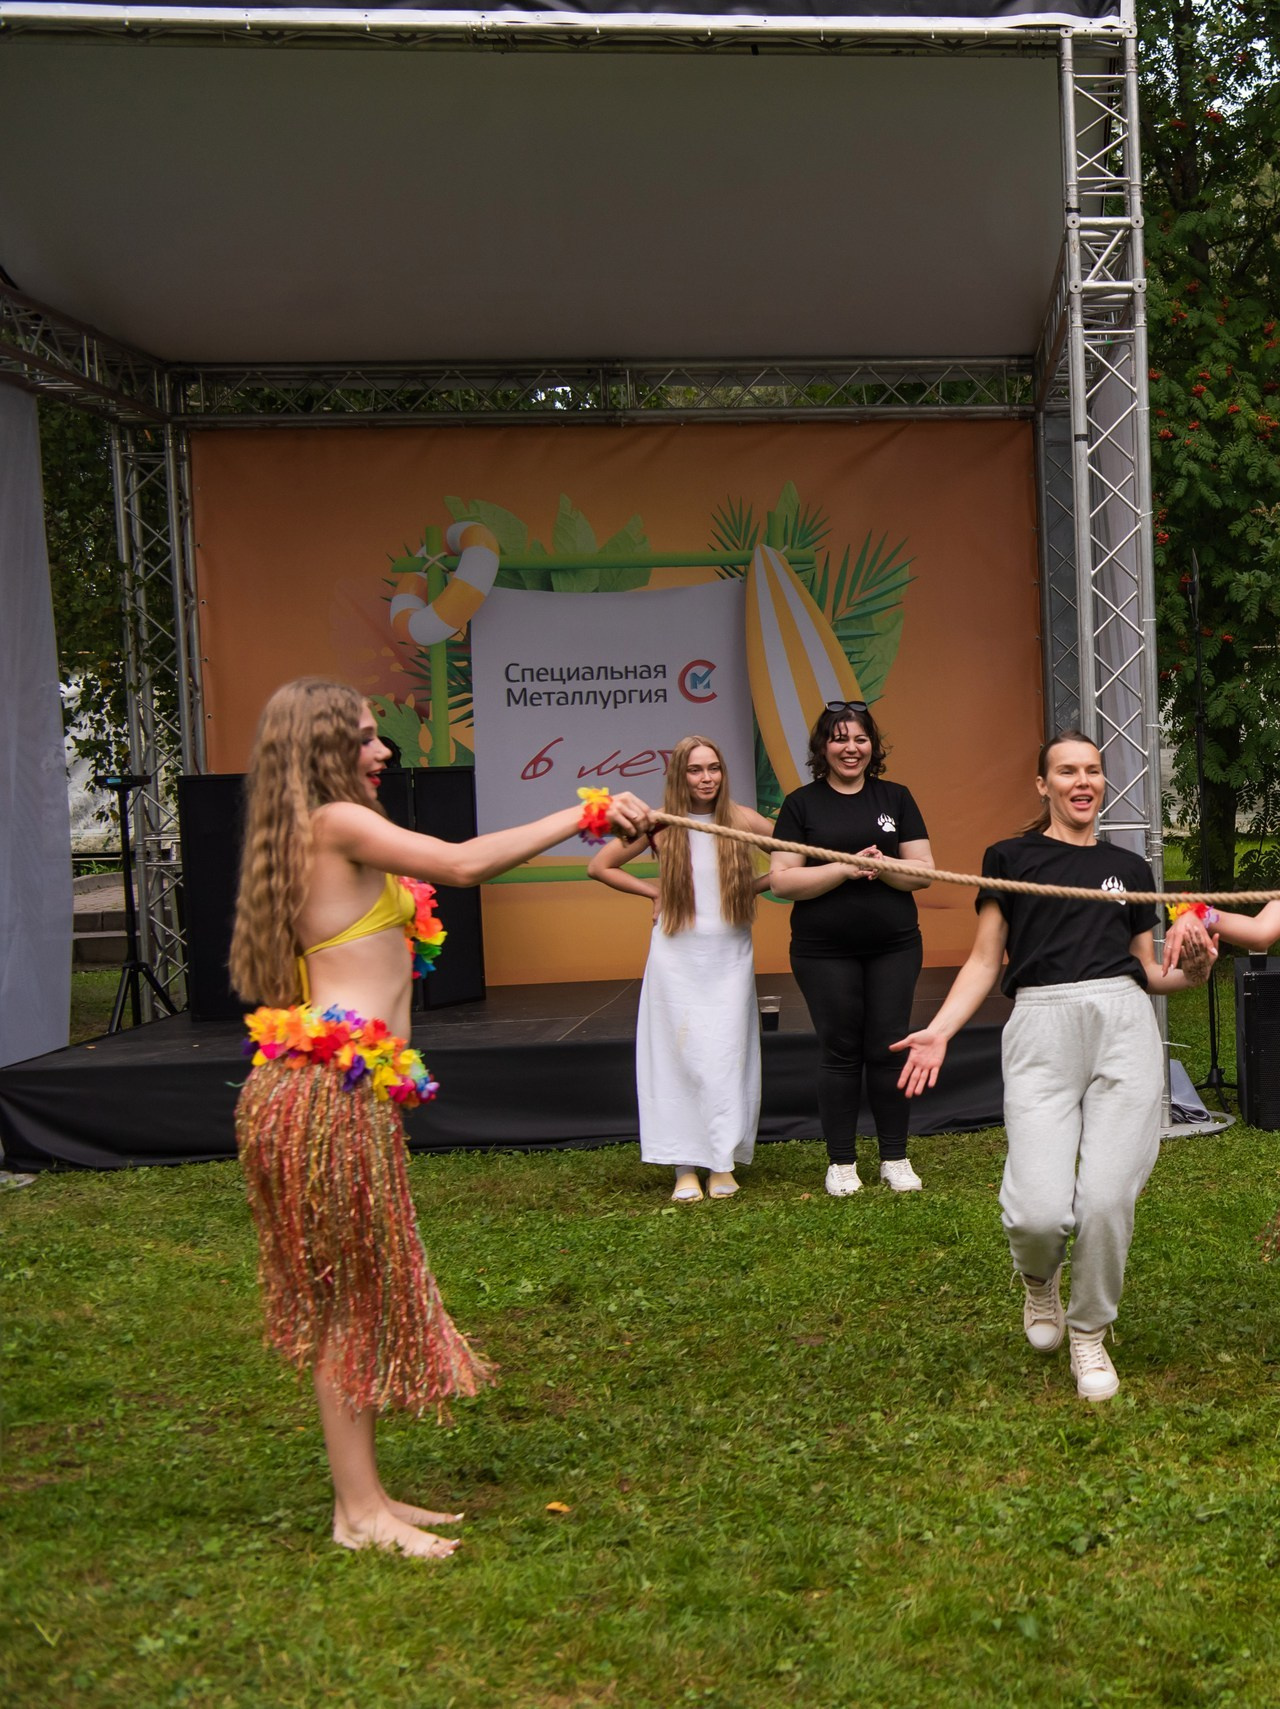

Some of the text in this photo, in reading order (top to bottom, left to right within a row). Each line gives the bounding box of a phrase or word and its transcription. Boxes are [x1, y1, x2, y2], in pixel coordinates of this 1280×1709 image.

[504, 662, 667, 685] Специальная
[506, 687, 668, 710] Металлургия
[520, 736, 564, 781] 6
